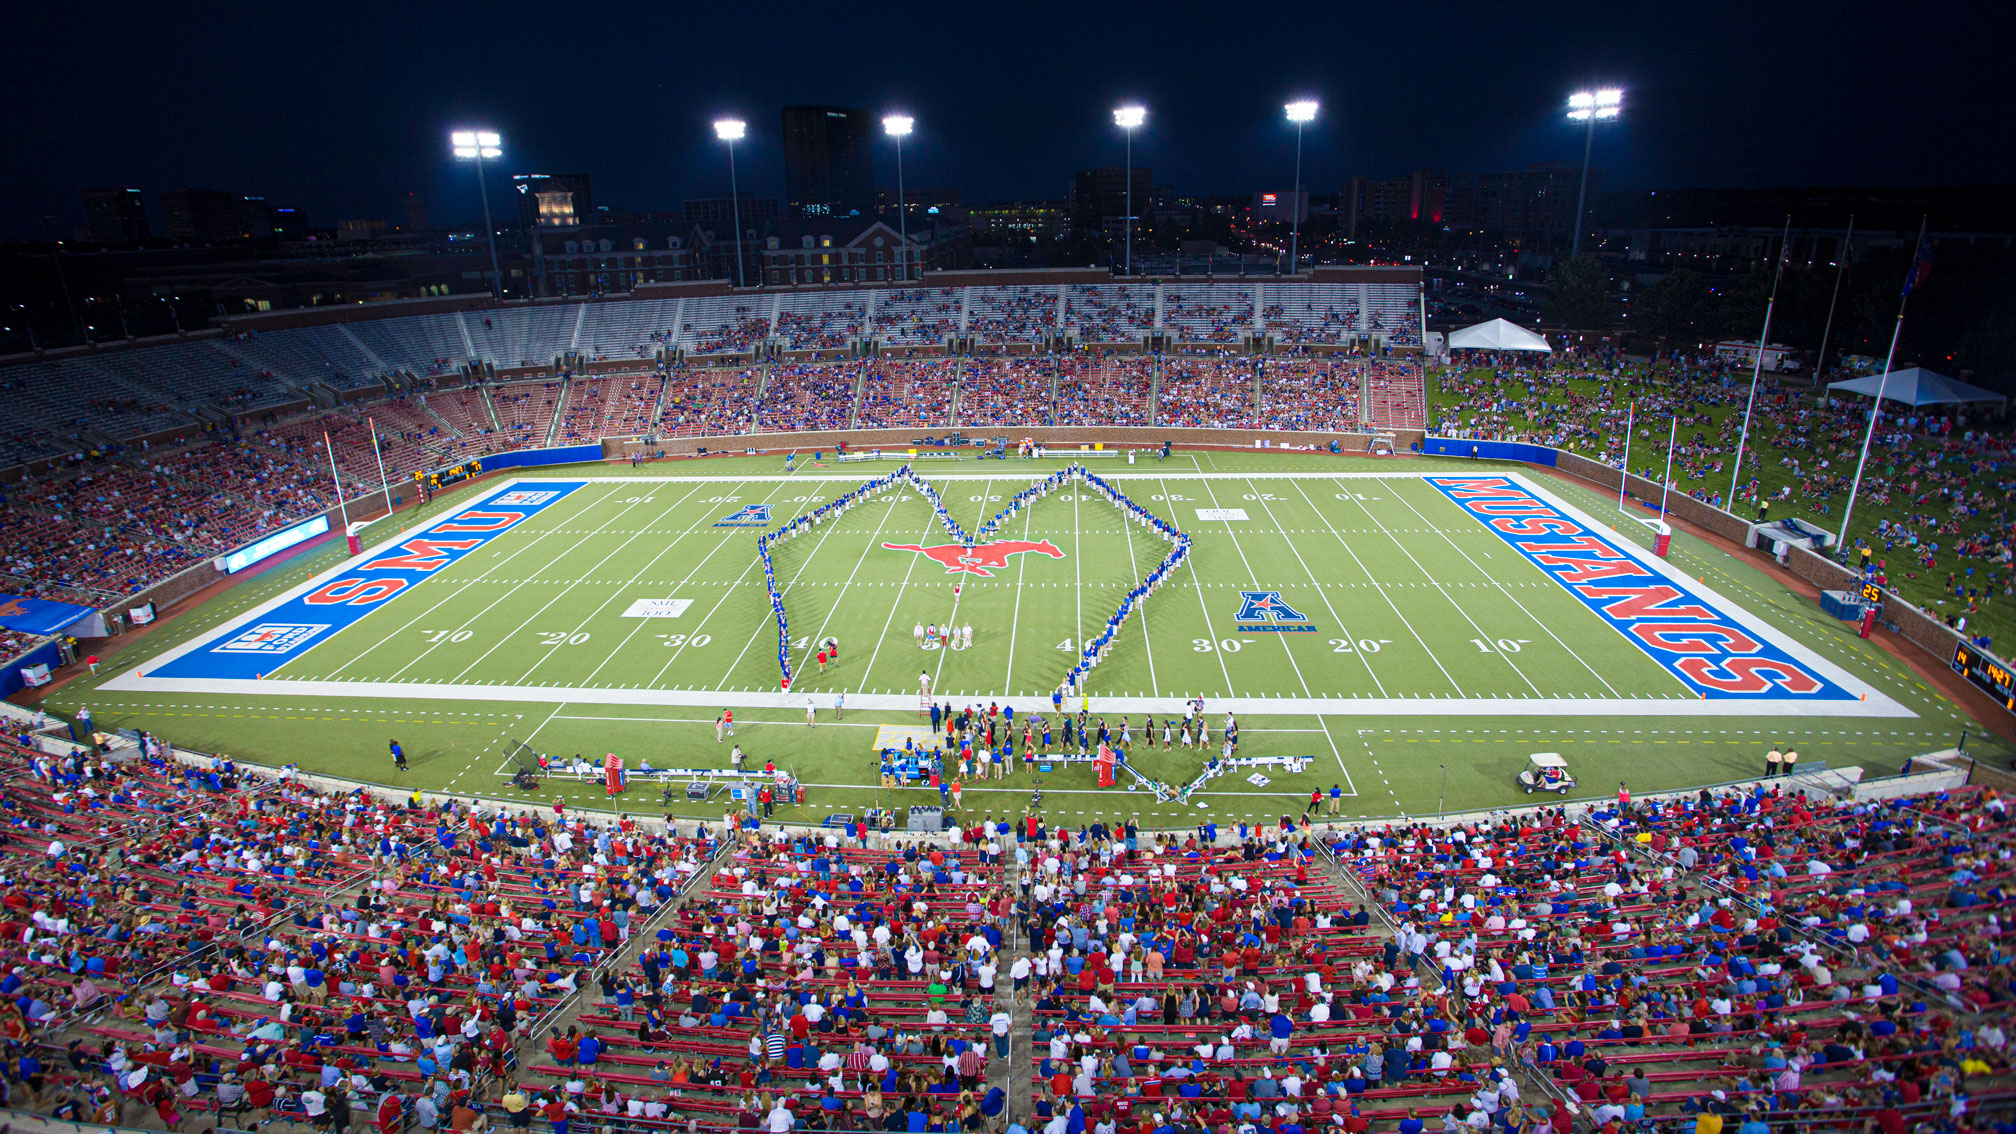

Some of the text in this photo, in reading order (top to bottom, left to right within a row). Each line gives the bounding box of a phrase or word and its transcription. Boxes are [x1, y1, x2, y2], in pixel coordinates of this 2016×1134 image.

[303, 510, 526, 605] SMU
[1434, 476, 1825, 695] MUSTANGS
[1862, 583, 1879, 602] 25
[425, 629, 474, 644] 10
[1237, 625, 1319, 633] AMERICAN
[261, 626, 308, 650] FORD
[538, 631, 591, 645] 20
[662, 634, 712, 648] 30
[1192, 638, 1242, 653] 30
[1328, 638, 1381, 653] 20
[1470, 638, 1522, 653] 10
[1957, 650, 1967, 665] 14
